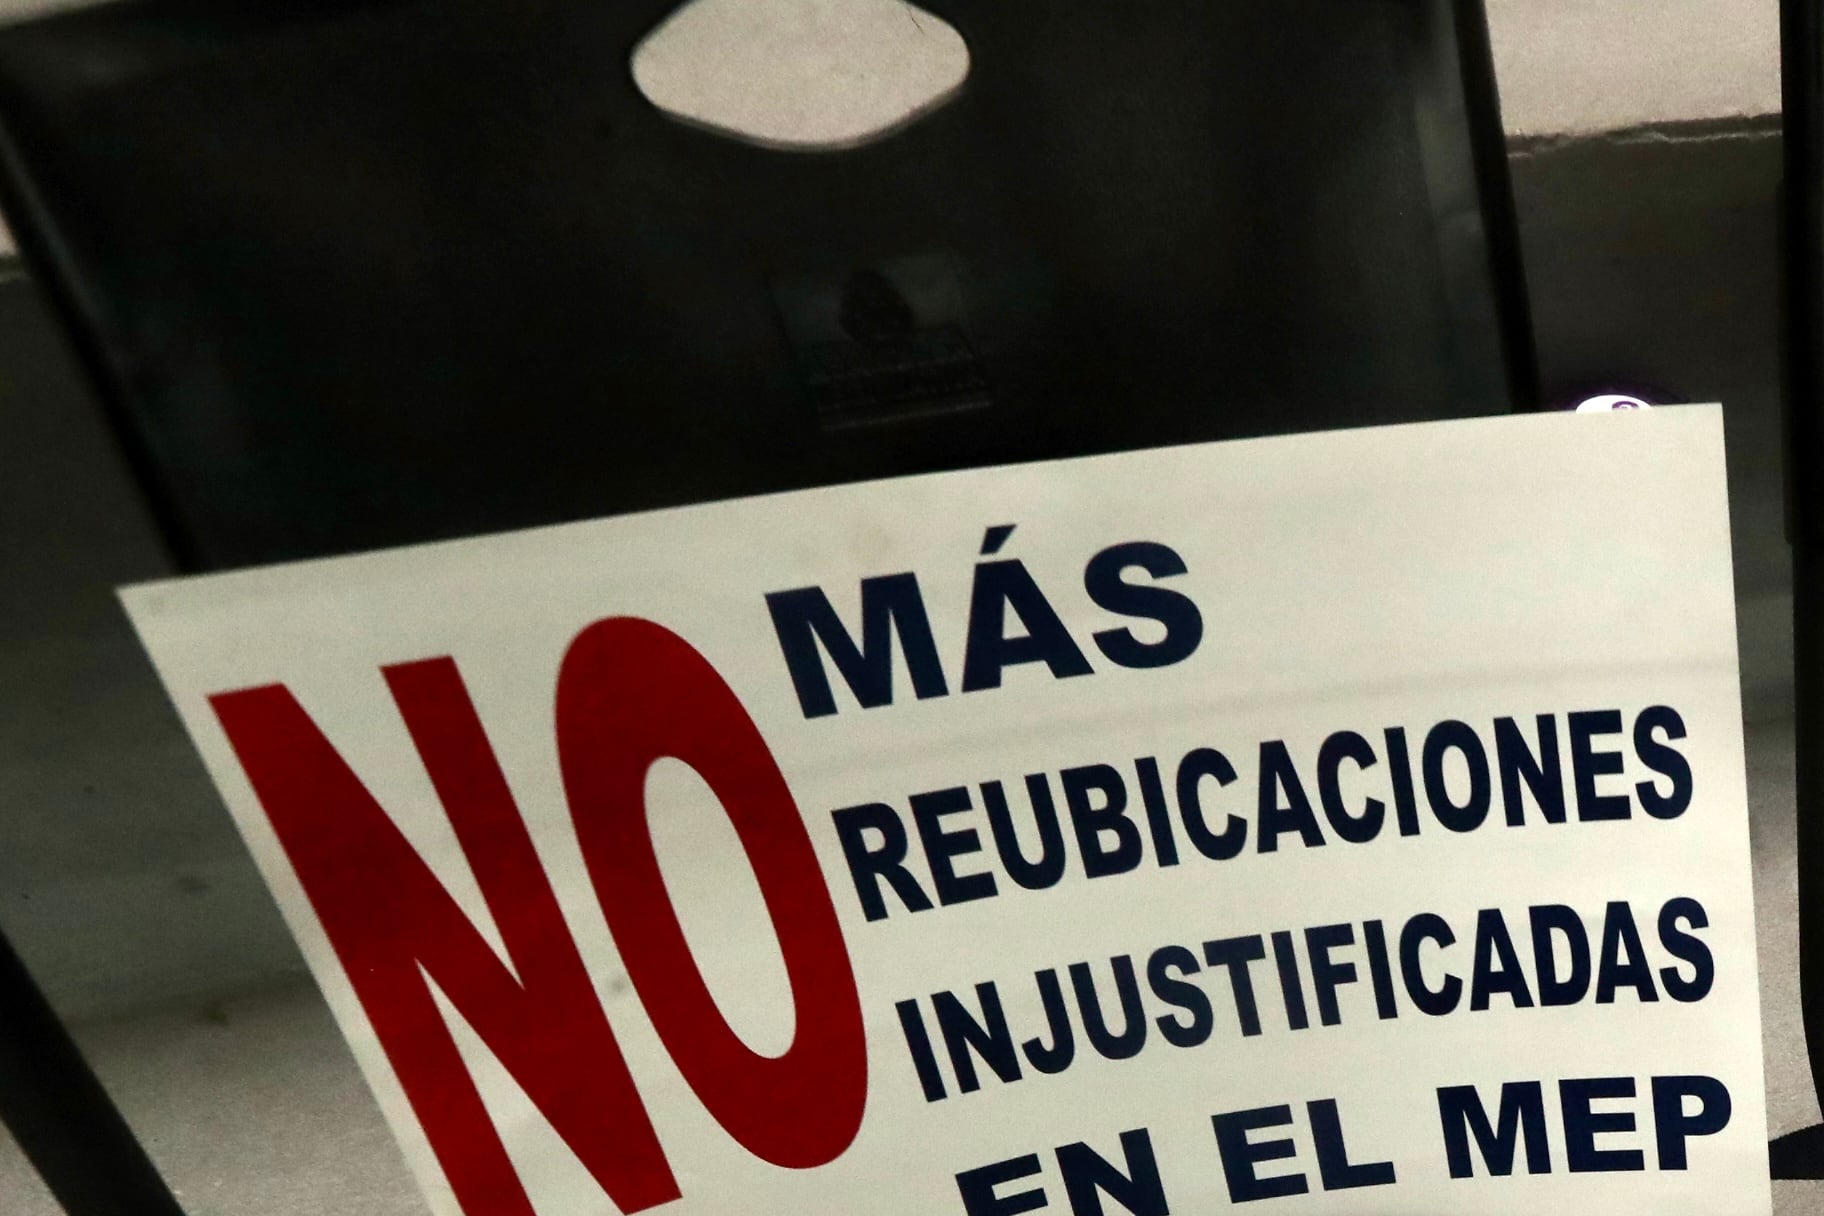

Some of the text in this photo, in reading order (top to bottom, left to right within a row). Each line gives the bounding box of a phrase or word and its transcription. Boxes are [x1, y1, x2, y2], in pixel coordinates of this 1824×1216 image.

[764, 524, 1203, 719] MÁS
[831, 706, 1692, 922] REUBICACIONES
[895, 897, 1714, 1102] INJUSTIFICADAS
[1211, 1099, 1396, 1203] EL
[1436, 1076, 1731, 1179] MEP
